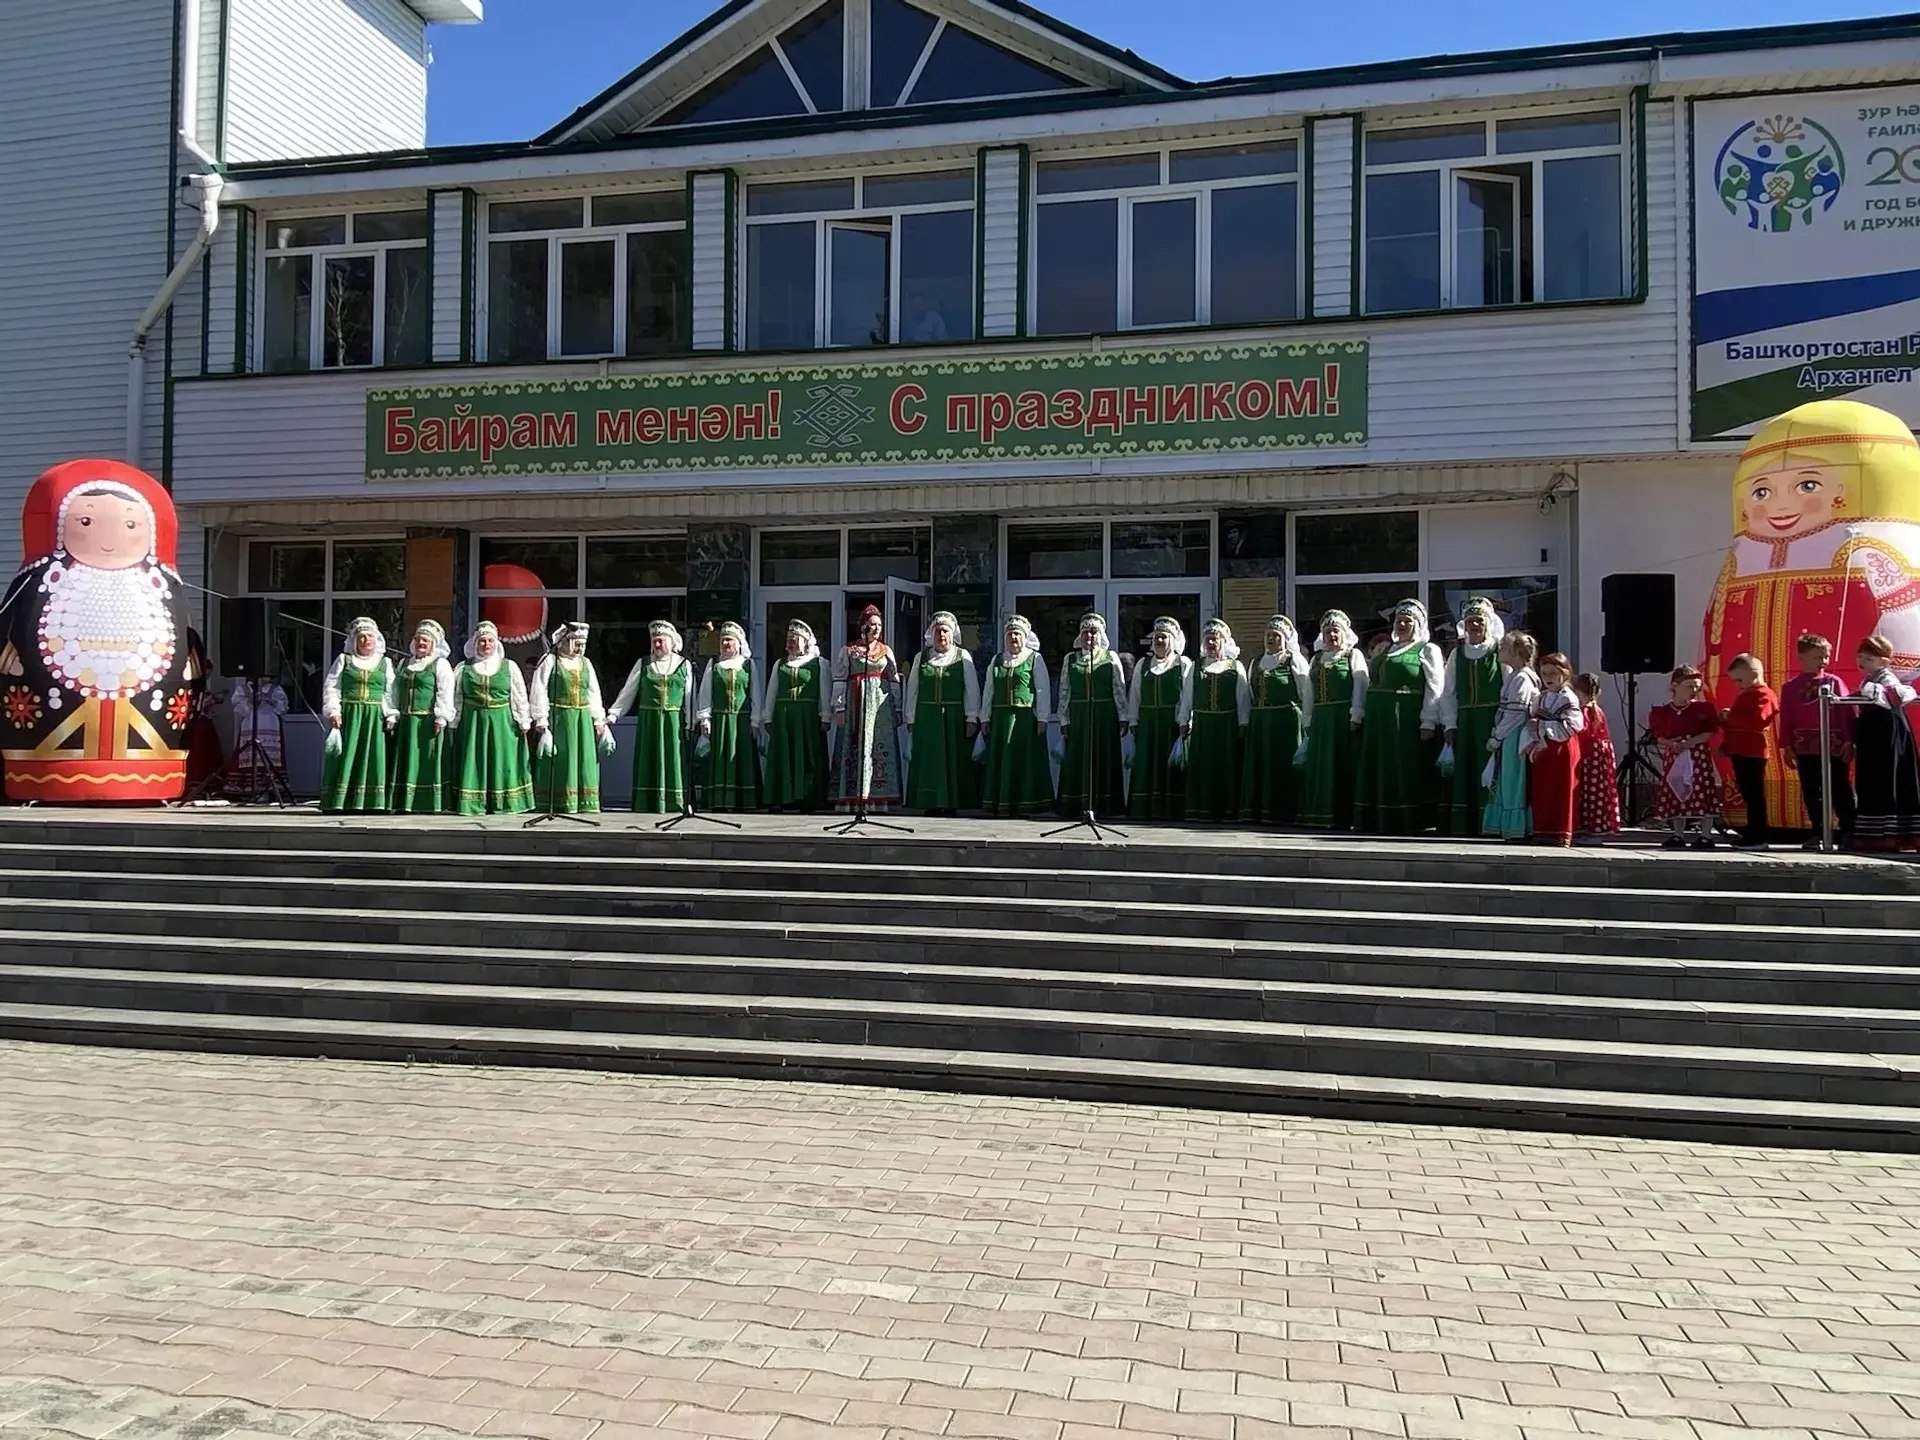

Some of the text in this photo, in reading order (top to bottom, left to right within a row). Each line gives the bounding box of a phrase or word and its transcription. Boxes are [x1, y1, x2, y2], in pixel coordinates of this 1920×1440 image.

[1868, 123, 1920, 138] ҒАИЛ
[1865, 198, 1901, 211] ГОД
[1844, 219, 1856, 231] И
[1798, 366, 1912, 390] Архангел
[889, 362, 1340, 445] С праздником!
[384, 389, 782, 463] Байрам менән!
